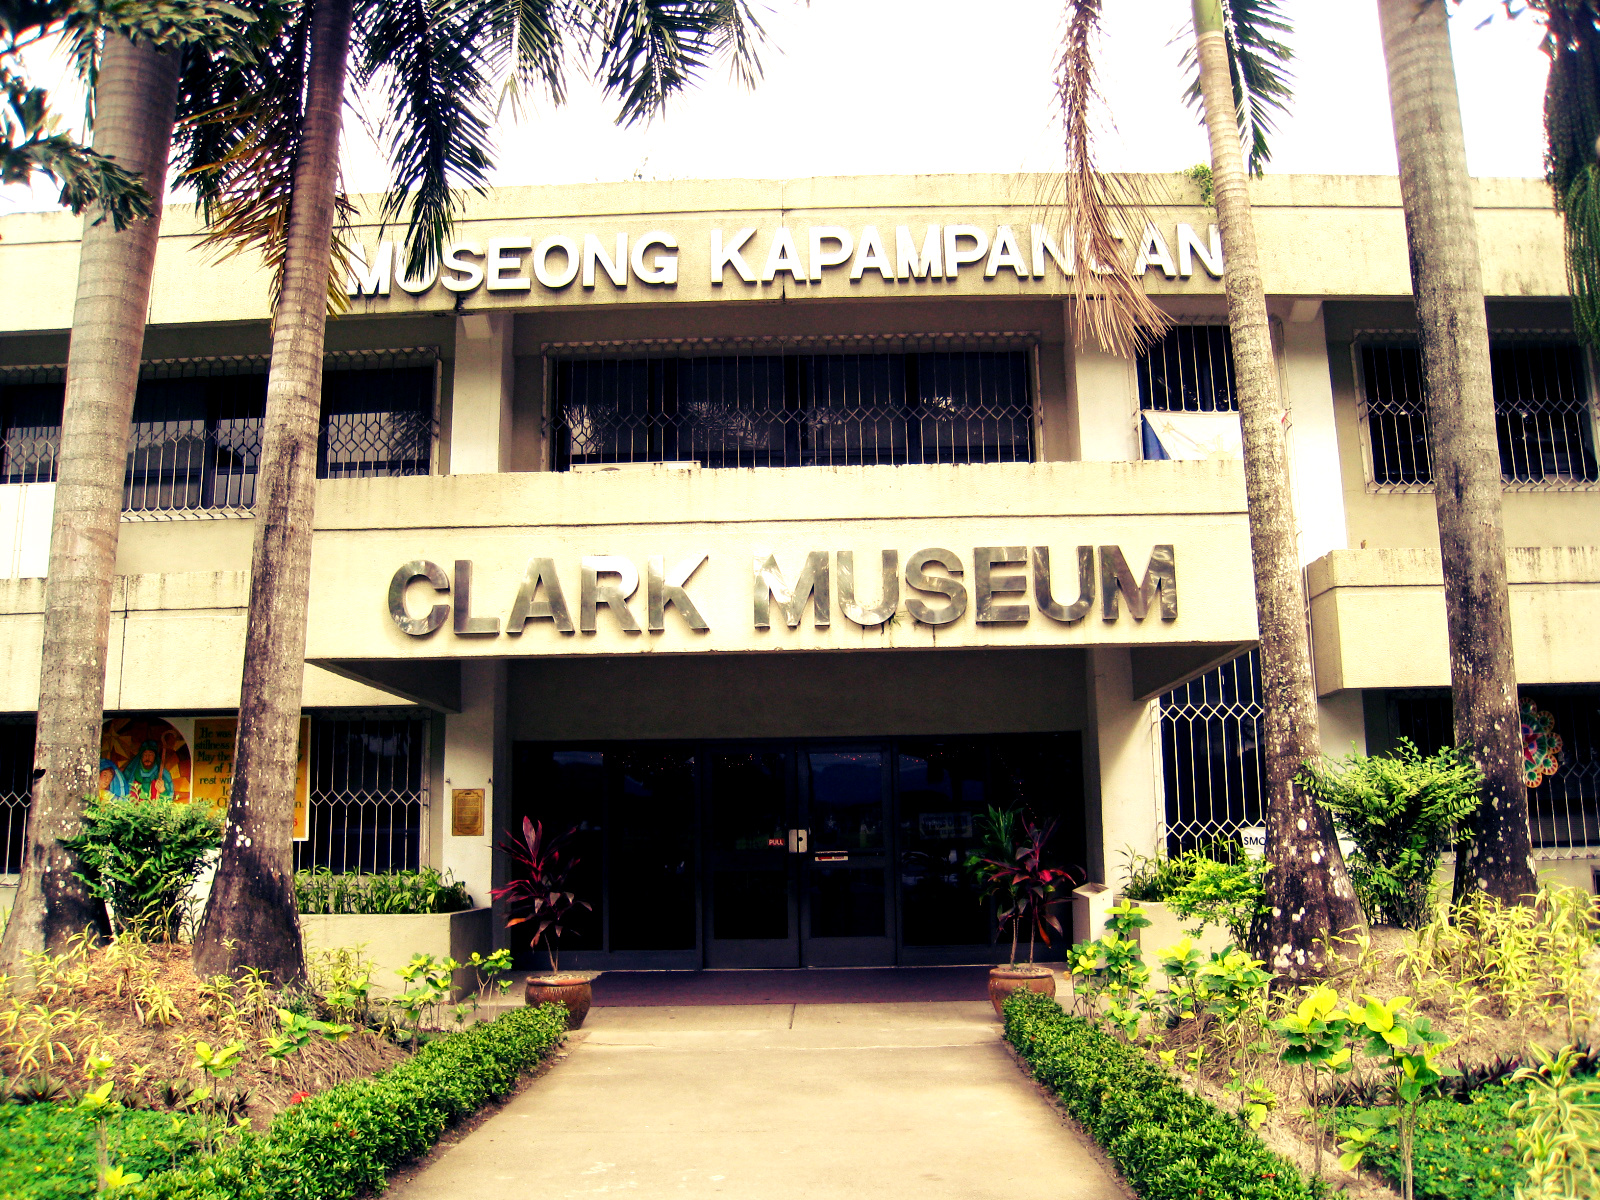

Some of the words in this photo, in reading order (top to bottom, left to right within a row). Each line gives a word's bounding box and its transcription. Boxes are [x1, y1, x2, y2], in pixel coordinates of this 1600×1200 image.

[346, 230, 679, 297] MUSEONG
[388, 555, 710, 637] CLARK
[753, 544, 1178, 629] MUSEUM
[199, 727, 213, 738] He
[197, 751, 214, 764] May
[217, 751, 231, 761] the
[214, 762, 224, 773] of
[200, 775, 216, 784] rest
